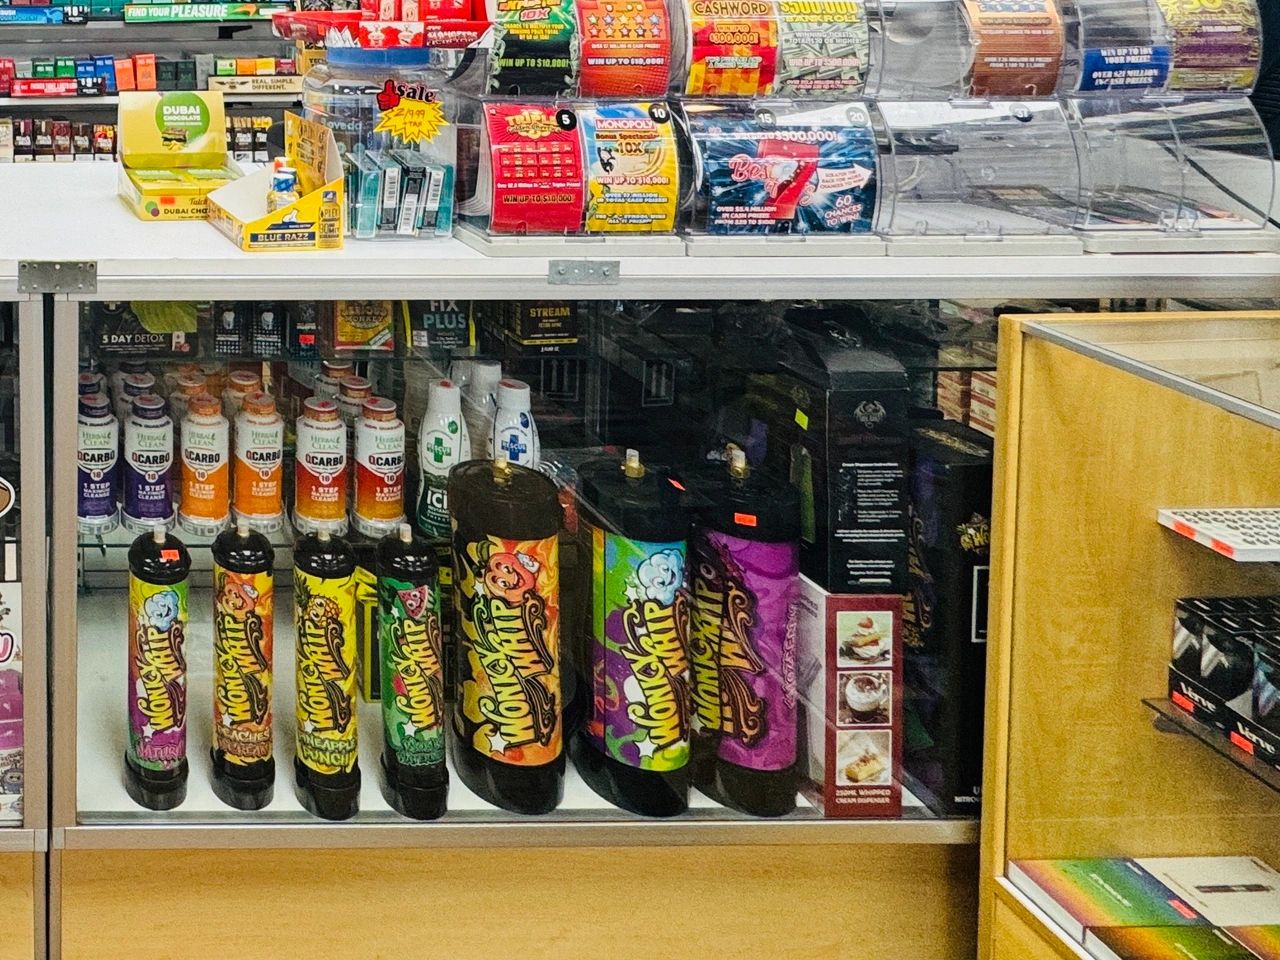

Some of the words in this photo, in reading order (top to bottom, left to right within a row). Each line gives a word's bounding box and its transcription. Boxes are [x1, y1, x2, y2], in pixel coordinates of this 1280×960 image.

[128, 8, 147, 17] FIND
[148, 7, 169, 17] YOUR
[171, 5, 228, 18] PLEASURE
[520, 8, 549, 20] 10X
[694, 0, 767, 16] CASHWORD
[499, 59, 514, 67] WIN
[526, 58, 536, 66] TO
[163, 106, 200, 115] DUBAI
[652, 108, 665, 118] 10
[562, 114, 570, 124] 5
[759, 113, 770, 123] 15
[850, 112, 863, 122] 20
[597, 121, 654, 130] MONOPOLY
[617, 141, 643, 154] 10X
[836, 195, 852, 207] 60
[824, 204, 862, 220] CHANCES
[258, 233, 281, 242] BLUE
[285, 232, 309, 241] RAZZ
[429, 299, 459, 311] FIX
[530, 307, 570, 318] STREAM
[423, 314, 466, 329] PLUS
[103, 334, 109, 343] 5
[111, 334, 132, 343] DAY
[134, 334, 165, 343] DETOX
[132, 452, 170, 465] QCARBO
[185, 448, 220, 463] QCARBO
[246, 449, 281, 462] QCARBO
[305, 453, 344, 467] QCARBO
[1179, 681, 1217, 714] Verve
[1236, 720, 1276, 754] Verve
